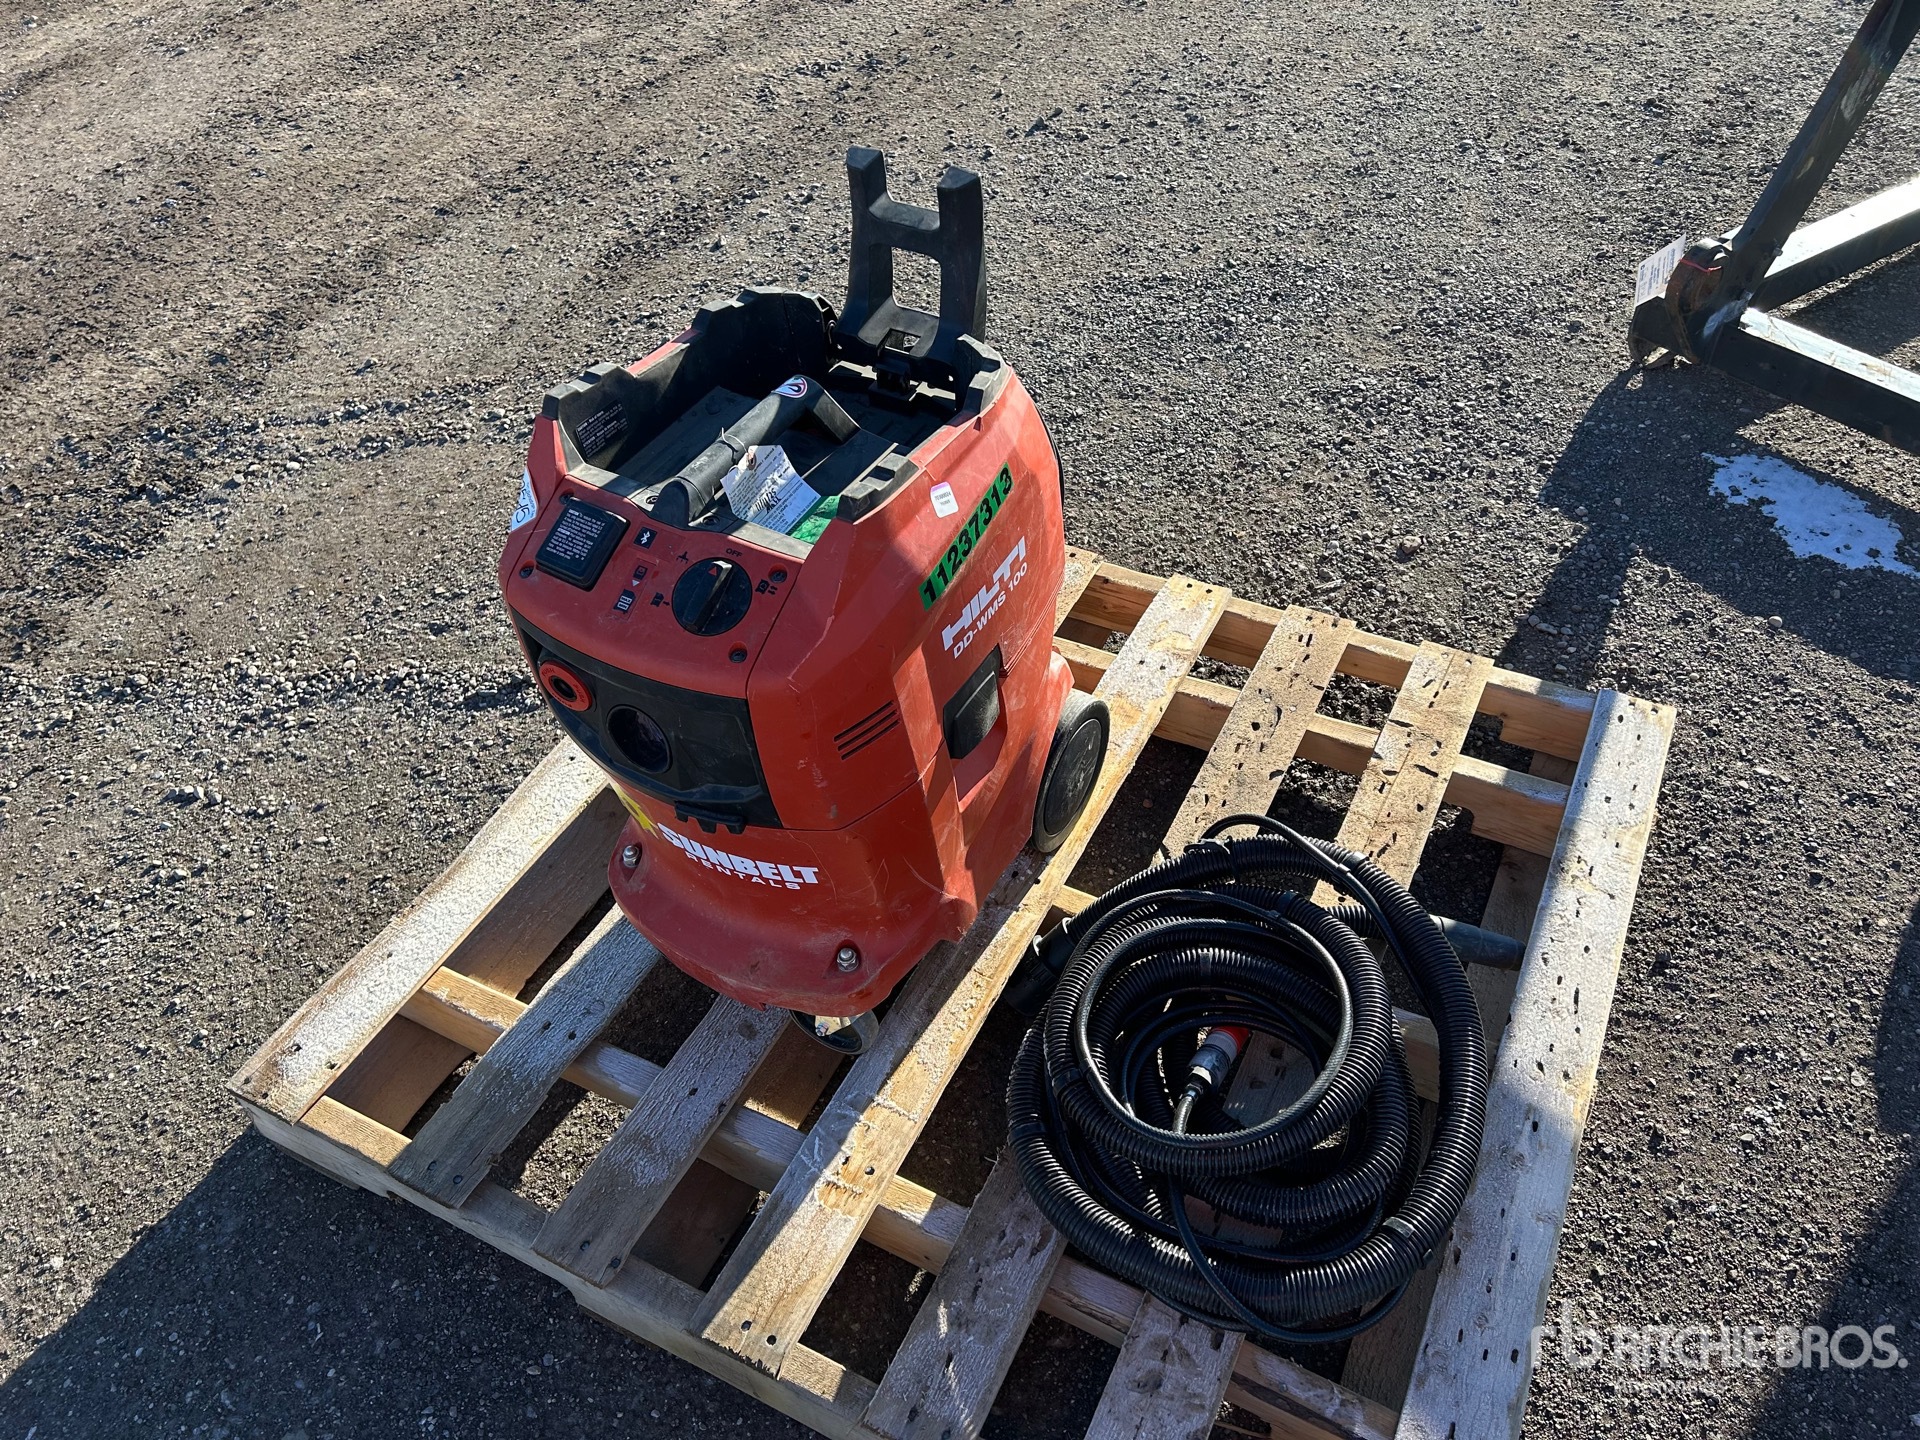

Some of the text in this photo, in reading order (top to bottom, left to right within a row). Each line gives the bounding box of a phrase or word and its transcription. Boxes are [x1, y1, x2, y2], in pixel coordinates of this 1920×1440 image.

[725, 548, 743, 557] OFF
[924, 467, 1013, 603] 11237313
[941, 536, 1026, 651] HILTI
[953, 561, 1028, 659] DD-WMS 100
[657, 822, 819, 884] SUNBELT
[685, 851, 800, 890] RENTALS
